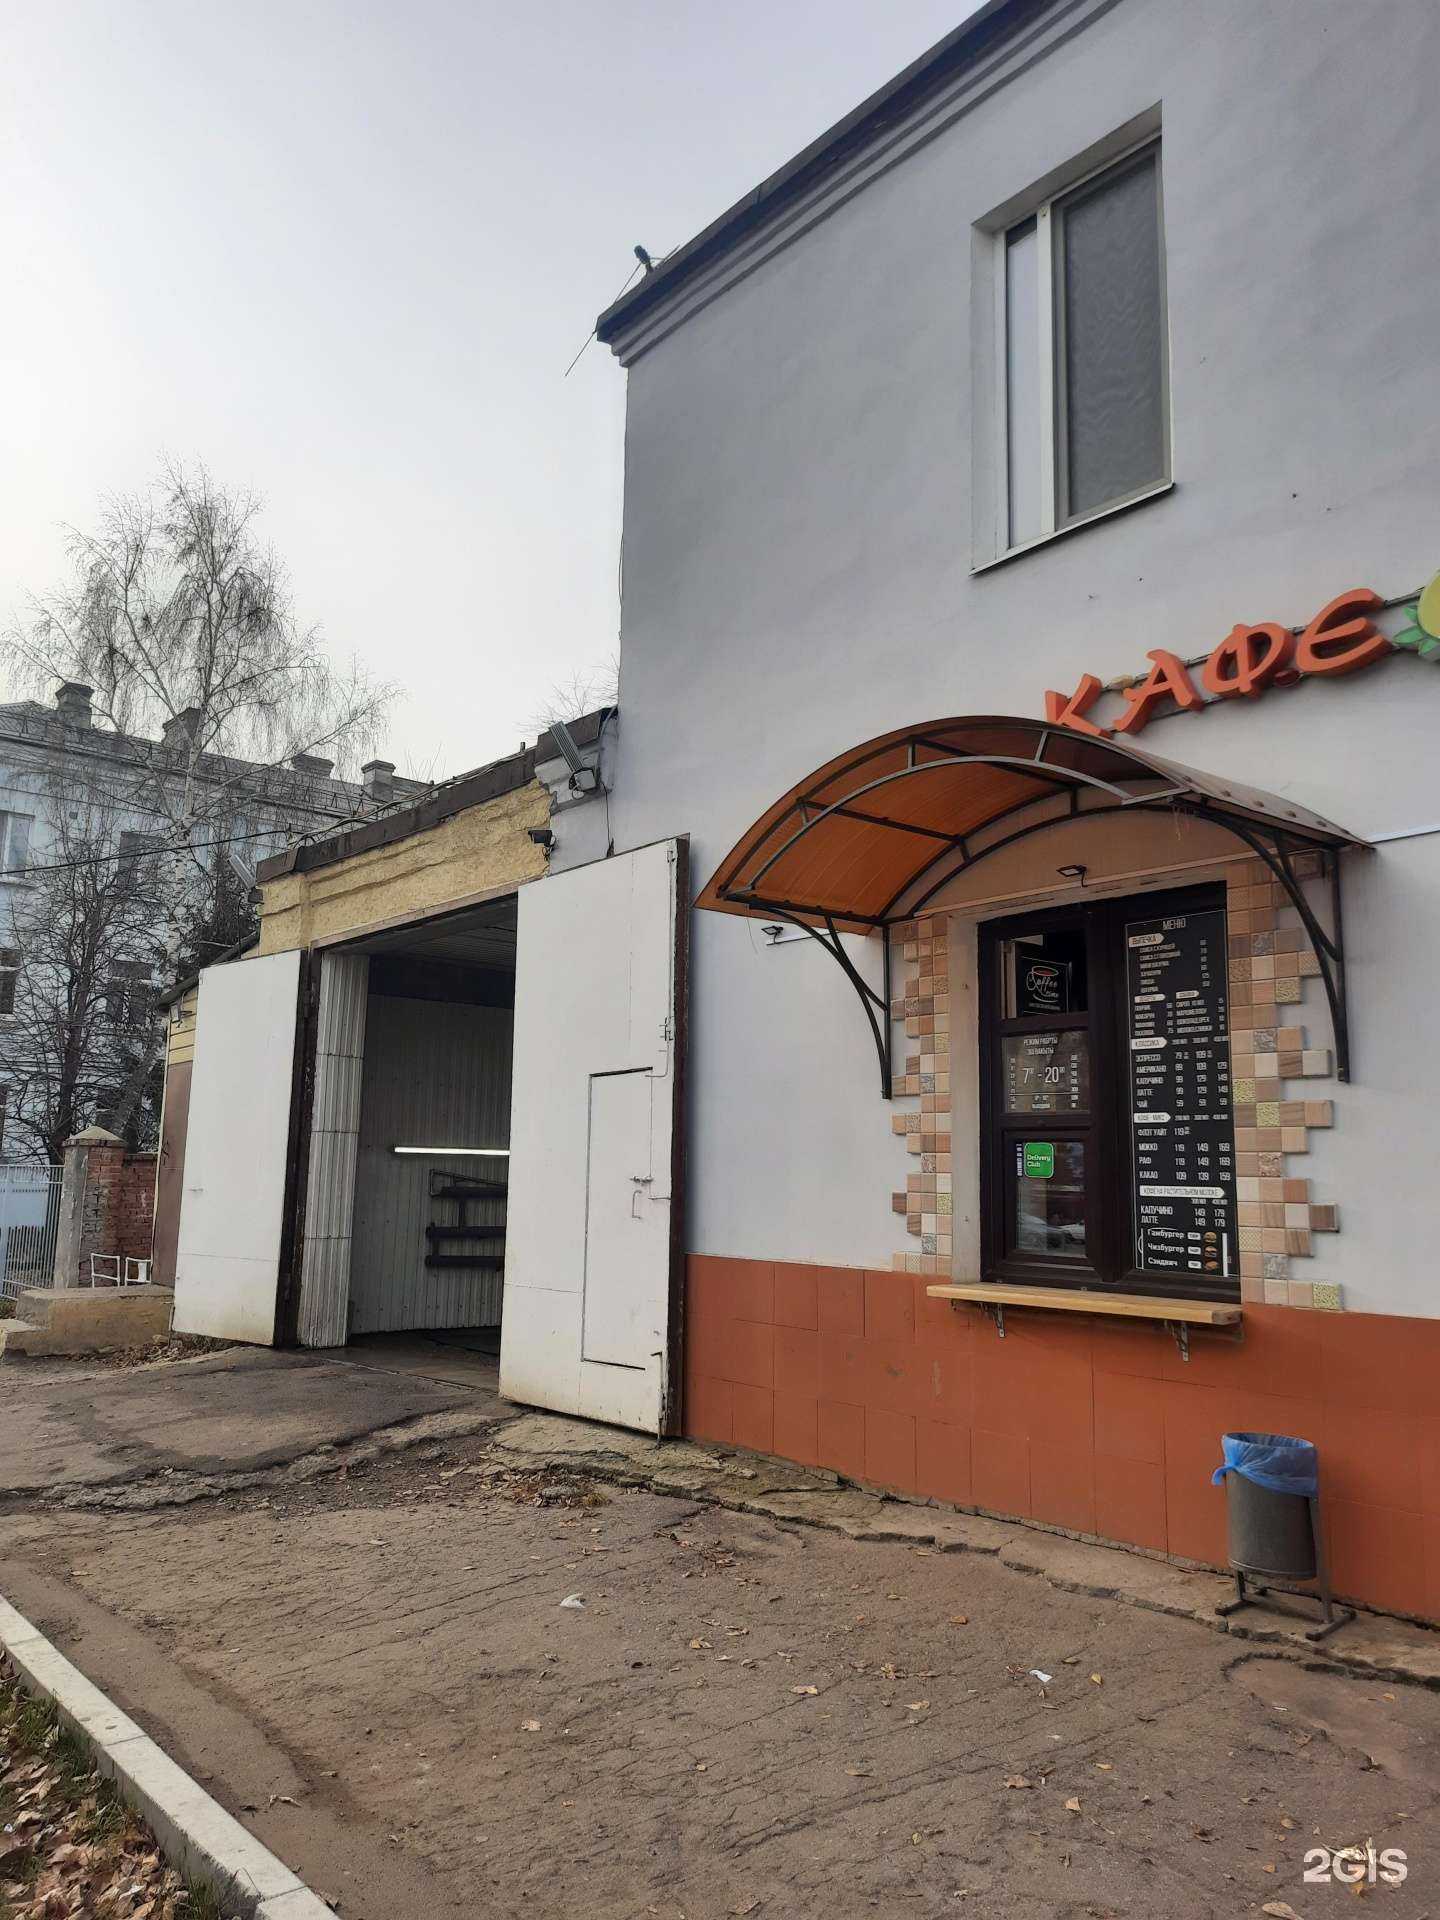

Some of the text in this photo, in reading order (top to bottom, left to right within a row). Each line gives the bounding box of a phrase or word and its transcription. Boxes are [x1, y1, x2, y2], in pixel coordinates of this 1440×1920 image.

[1045, 588, 1391, 740] КАФЕ
[1162, 918, 1186, 930] МЕНЮ
[1136, 1065, 1167, 1073] АМЕРИКАНО
[1137, 1088, 1153, 1096] ЛАТТЕ
[1197, 1142, 1208, 1151] 149
[1026, 1154, 1051, 1162] Delivery
[1197, 1157, 1209, 1166] 149
[1140, 1171, 1158, 1179] КАКАО
[1140, 1205, 1225, 1217] КАПУЧИНО 149 179
[1141, 1215, 1226, 1227] ЛАТТЕ 149 179
[1147, 1229, 1184, 1239] Гамбургер
[1147, 1243, 1185, 1253] Чизбургер
[1147, 1257, 1178, 1266] Сэндвич
